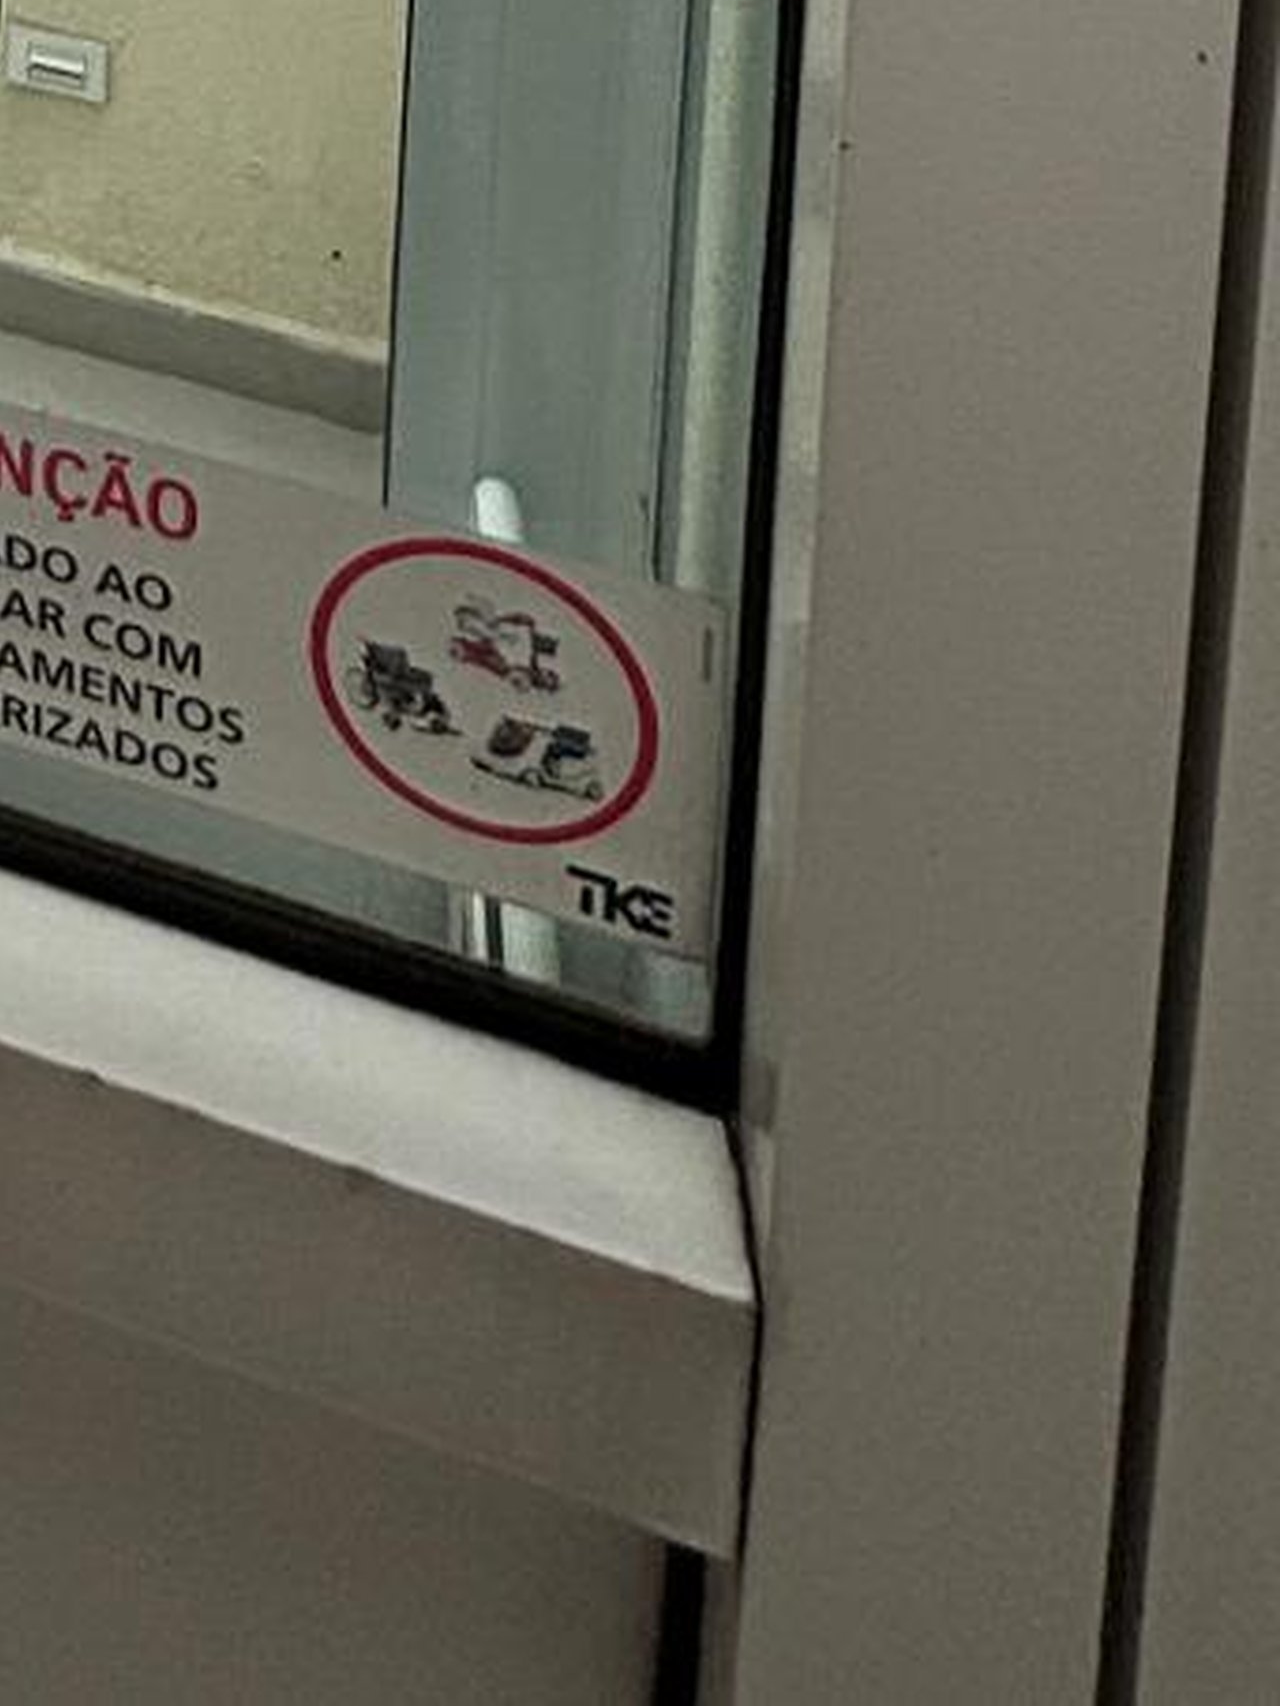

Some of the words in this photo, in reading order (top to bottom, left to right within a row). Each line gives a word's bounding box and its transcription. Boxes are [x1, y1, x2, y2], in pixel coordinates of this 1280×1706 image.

[96, 564, 173, 611] AO
[84, 614, 202, 677] COM
[566, 864, 674, 940] TKE
